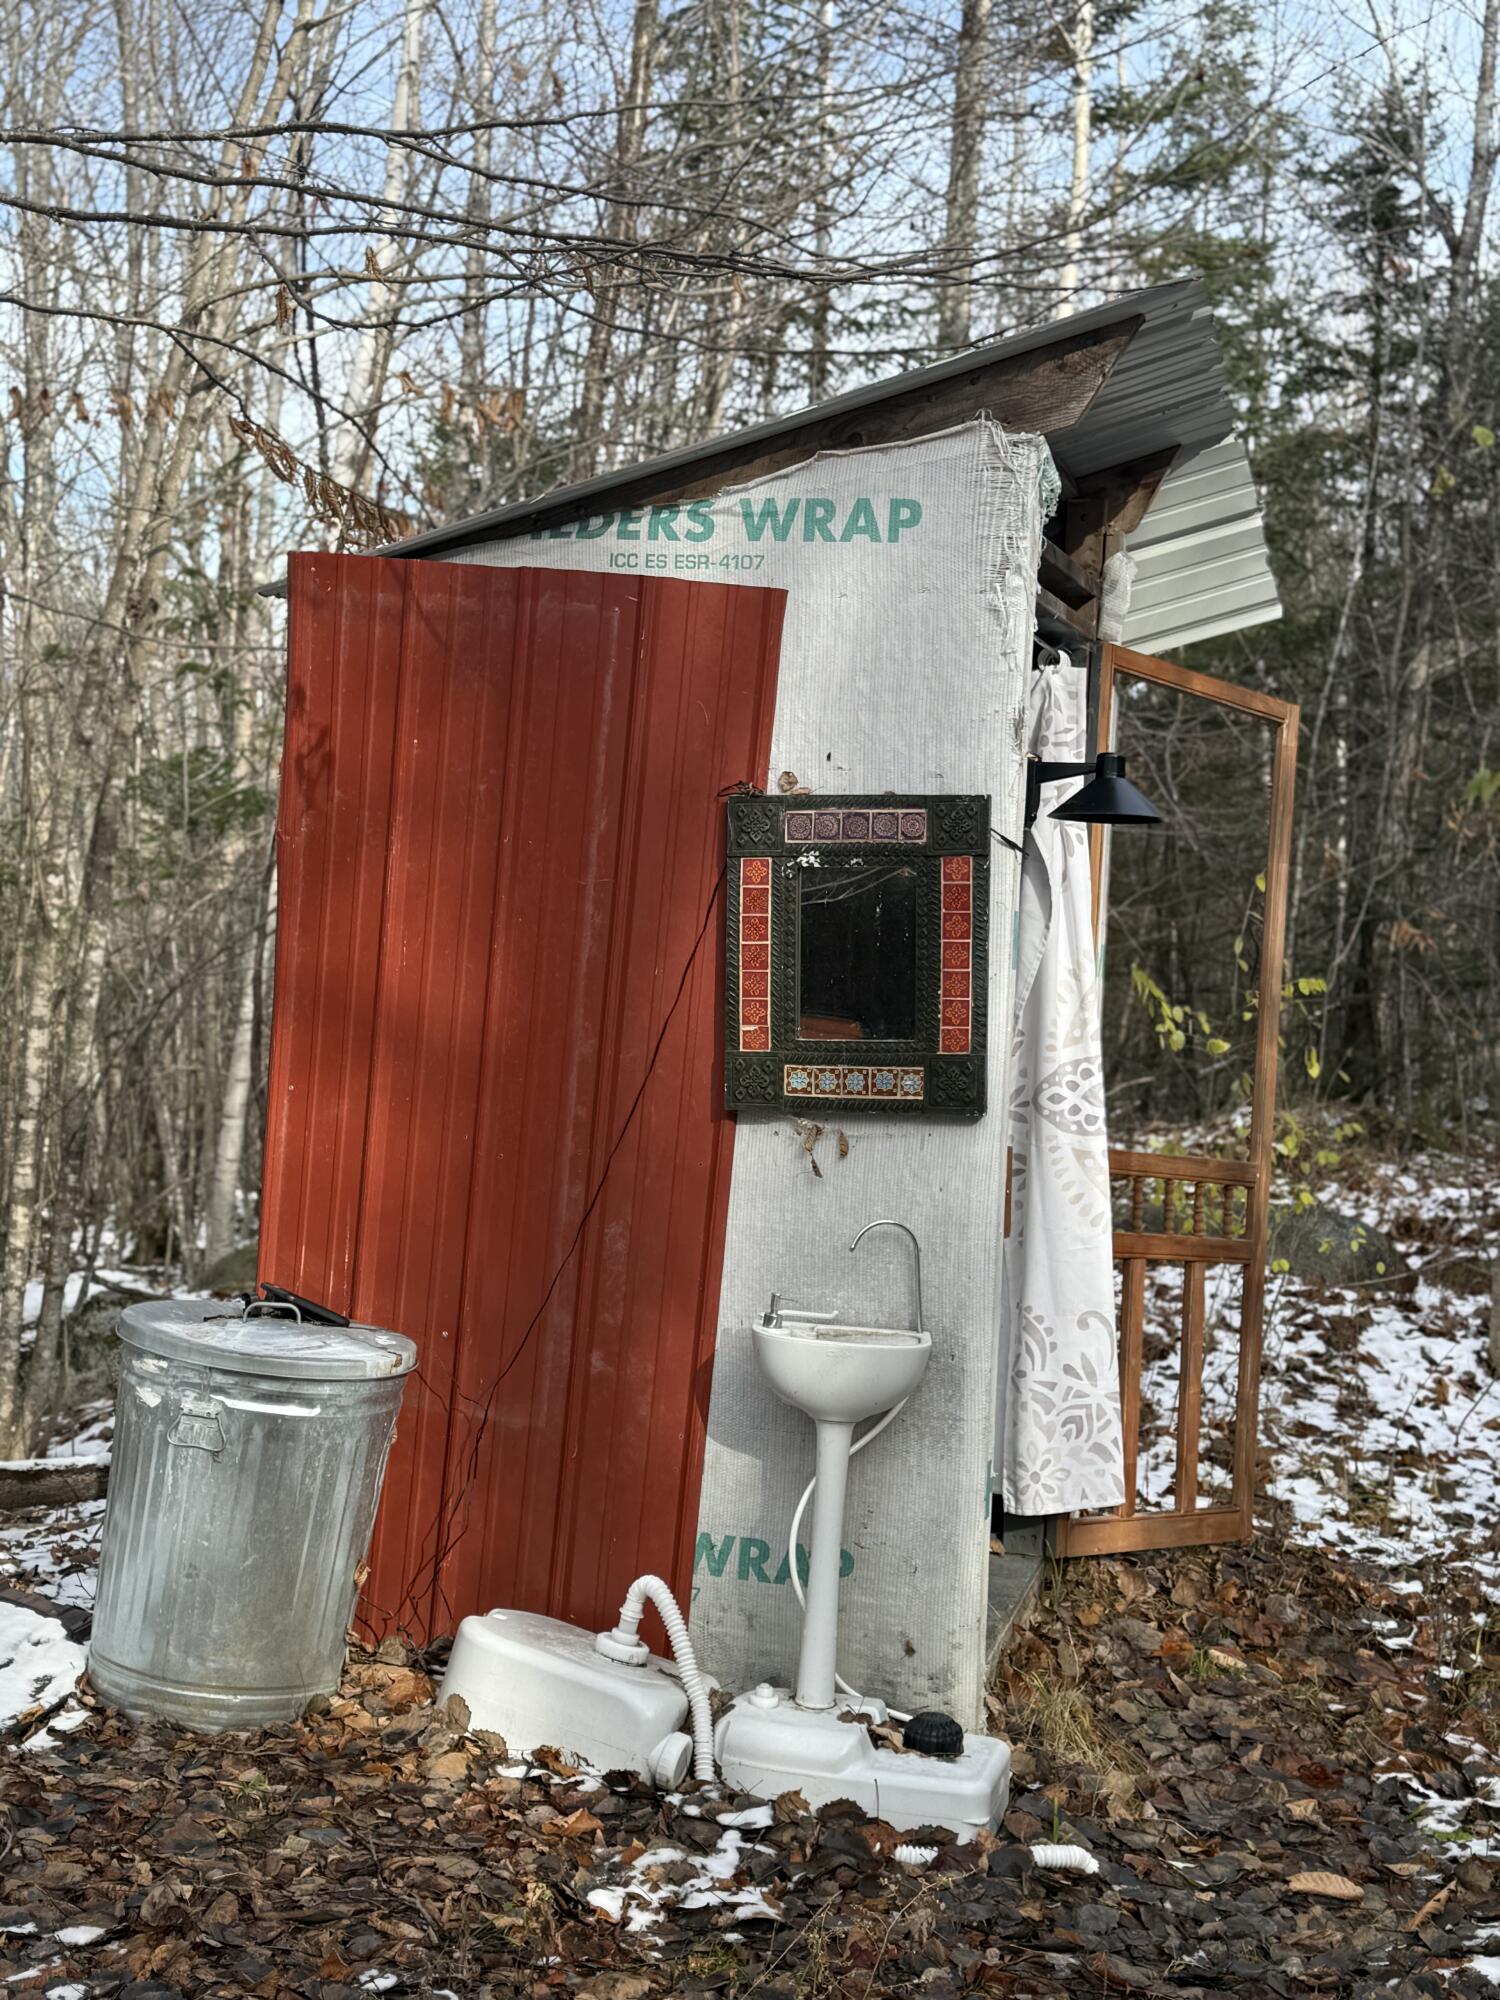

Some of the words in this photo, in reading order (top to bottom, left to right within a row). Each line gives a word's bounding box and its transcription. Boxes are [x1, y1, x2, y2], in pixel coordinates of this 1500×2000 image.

[528, 500, 715, 542] DERS
[739, 498, 923, 543] WRAP
[609, 553, 639, 569] ICC
[645, 554, 668, 569] ES
[674, 554, 765, 570] ESR-4107
